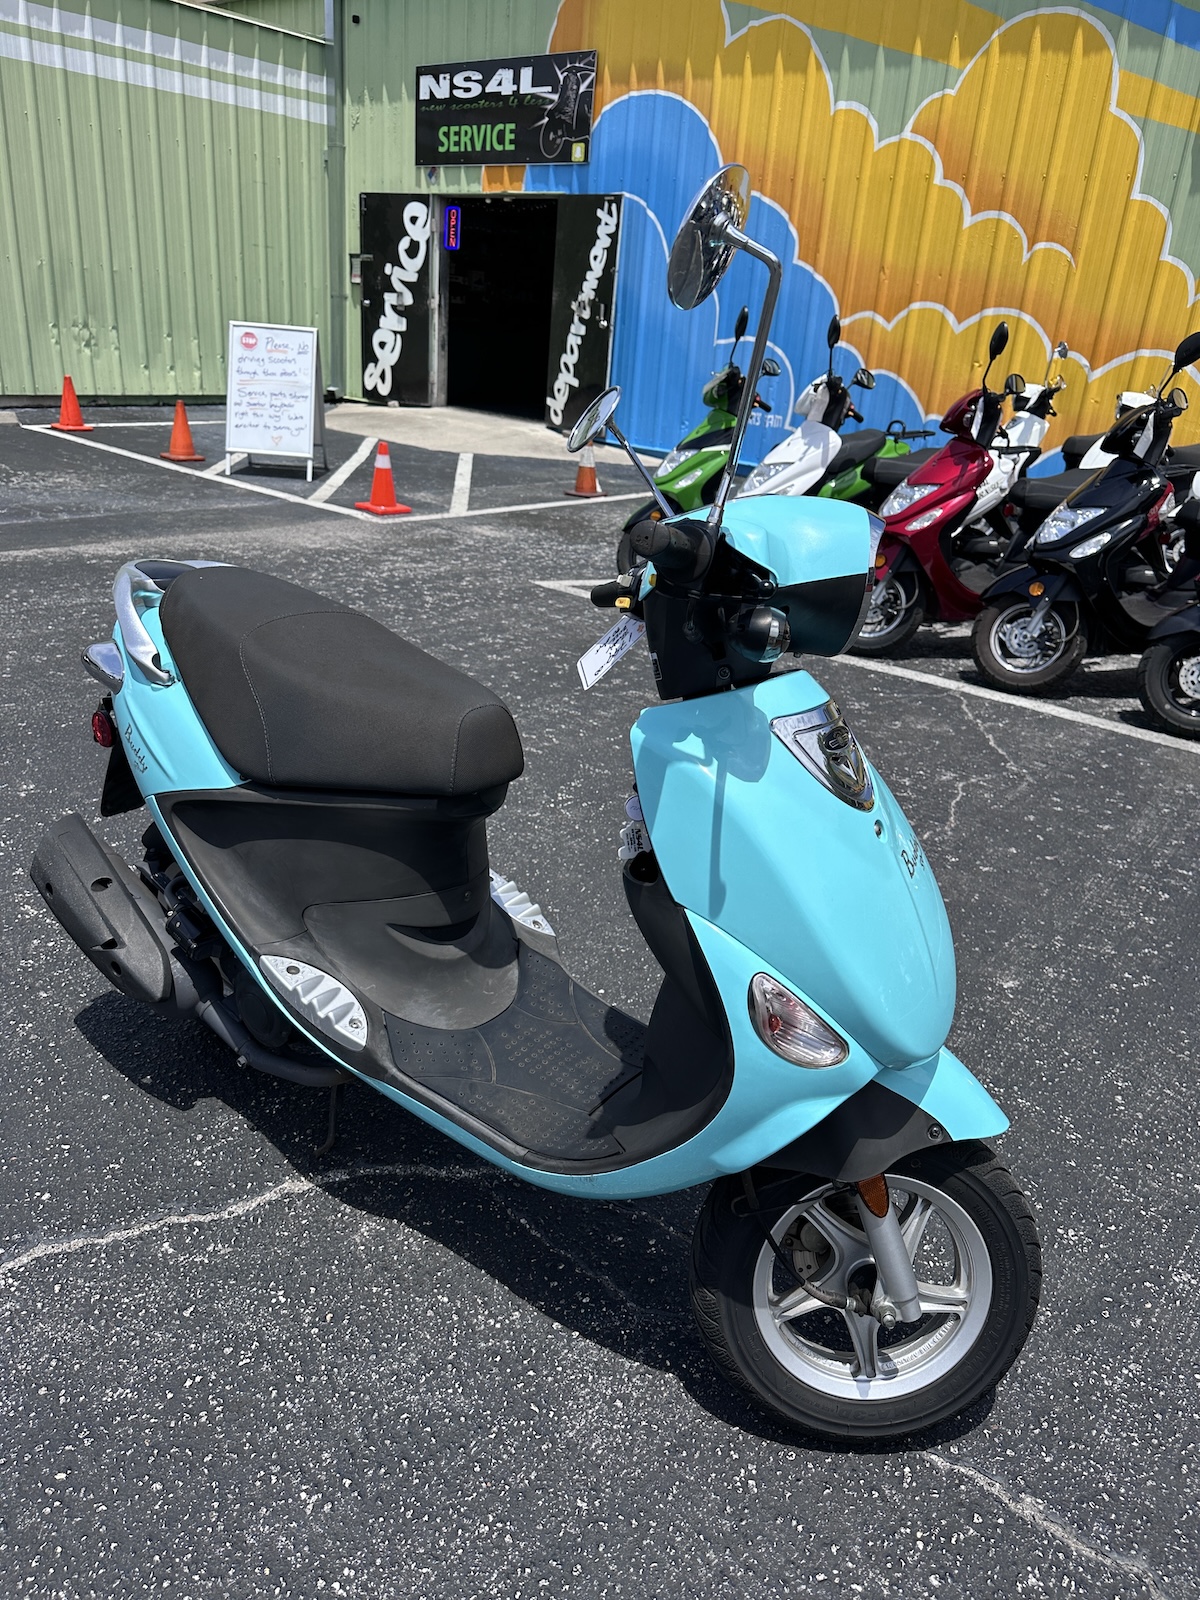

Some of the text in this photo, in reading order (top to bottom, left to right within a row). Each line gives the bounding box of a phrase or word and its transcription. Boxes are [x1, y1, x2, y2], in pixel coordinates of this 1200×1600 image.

[419, 66, 552, 100] NS4L
[420, 94, 552, 112] new scooters 4 less
[438, 123, 516, 153] SERVICE
[449, 209, 457, 247] OPEN
[364, 201, 431, 396] service
[546, 201, 618, 426] department
[242, 337, 256, 345] STOP
[297, 341, 309, 352] No
[124, 721, 148, 774] Buddy
